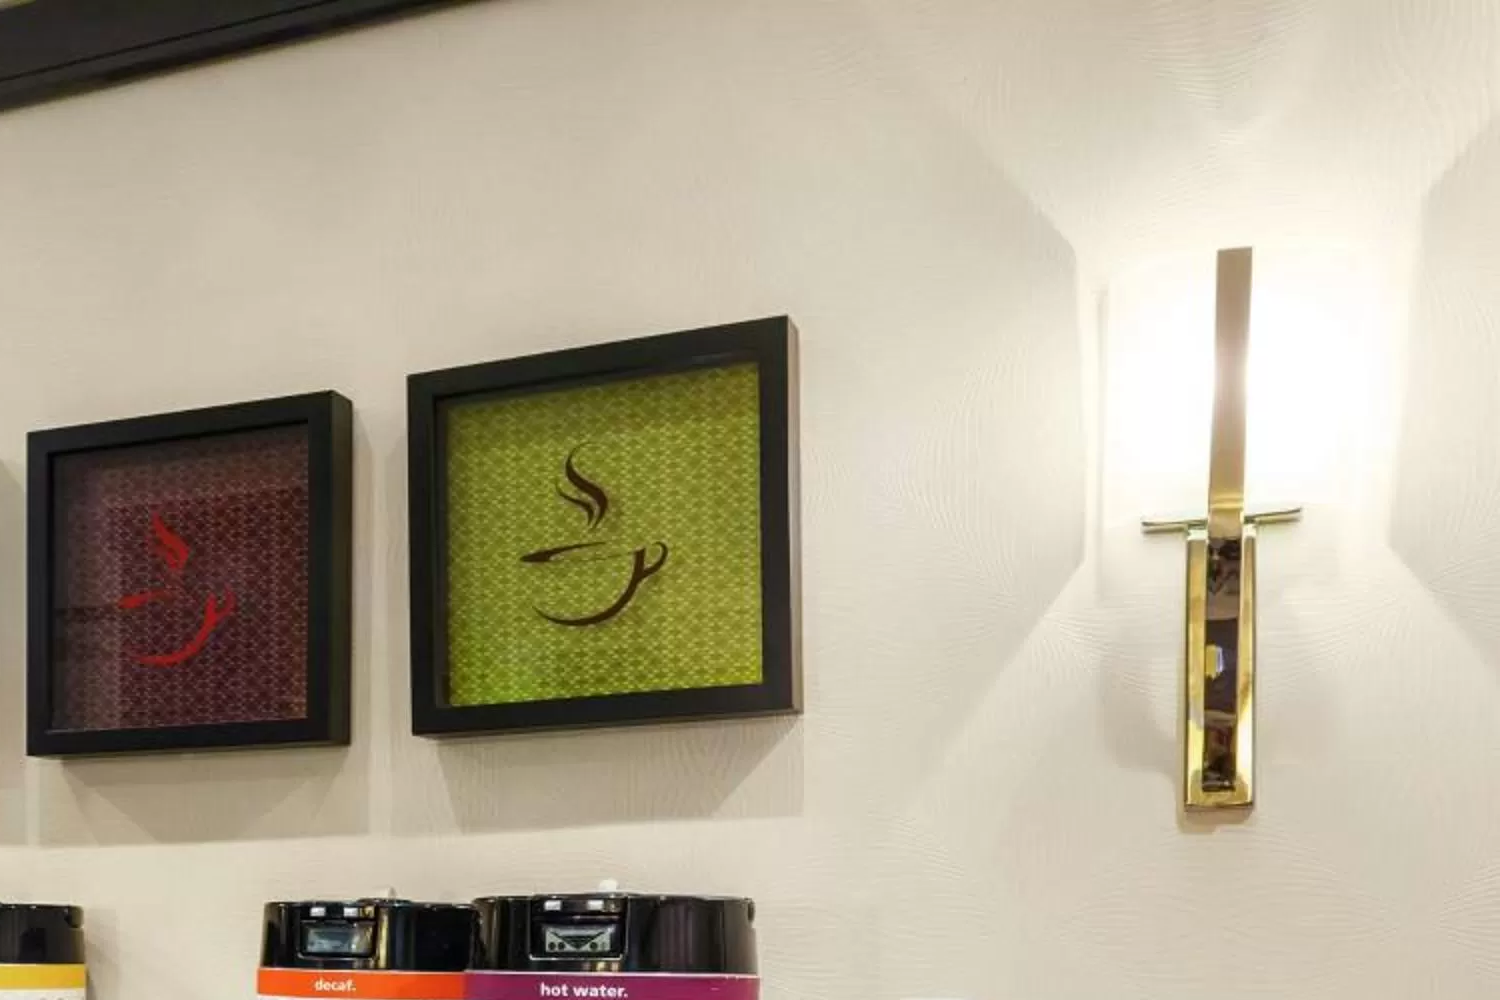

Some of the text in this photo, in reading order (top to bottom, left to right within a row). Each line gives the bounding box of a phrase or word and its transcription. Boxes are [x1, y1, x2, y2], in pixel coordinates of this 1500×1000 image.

[315, 977, 357, 992] decaf.
[540, 981, 629, 999] hot water.
